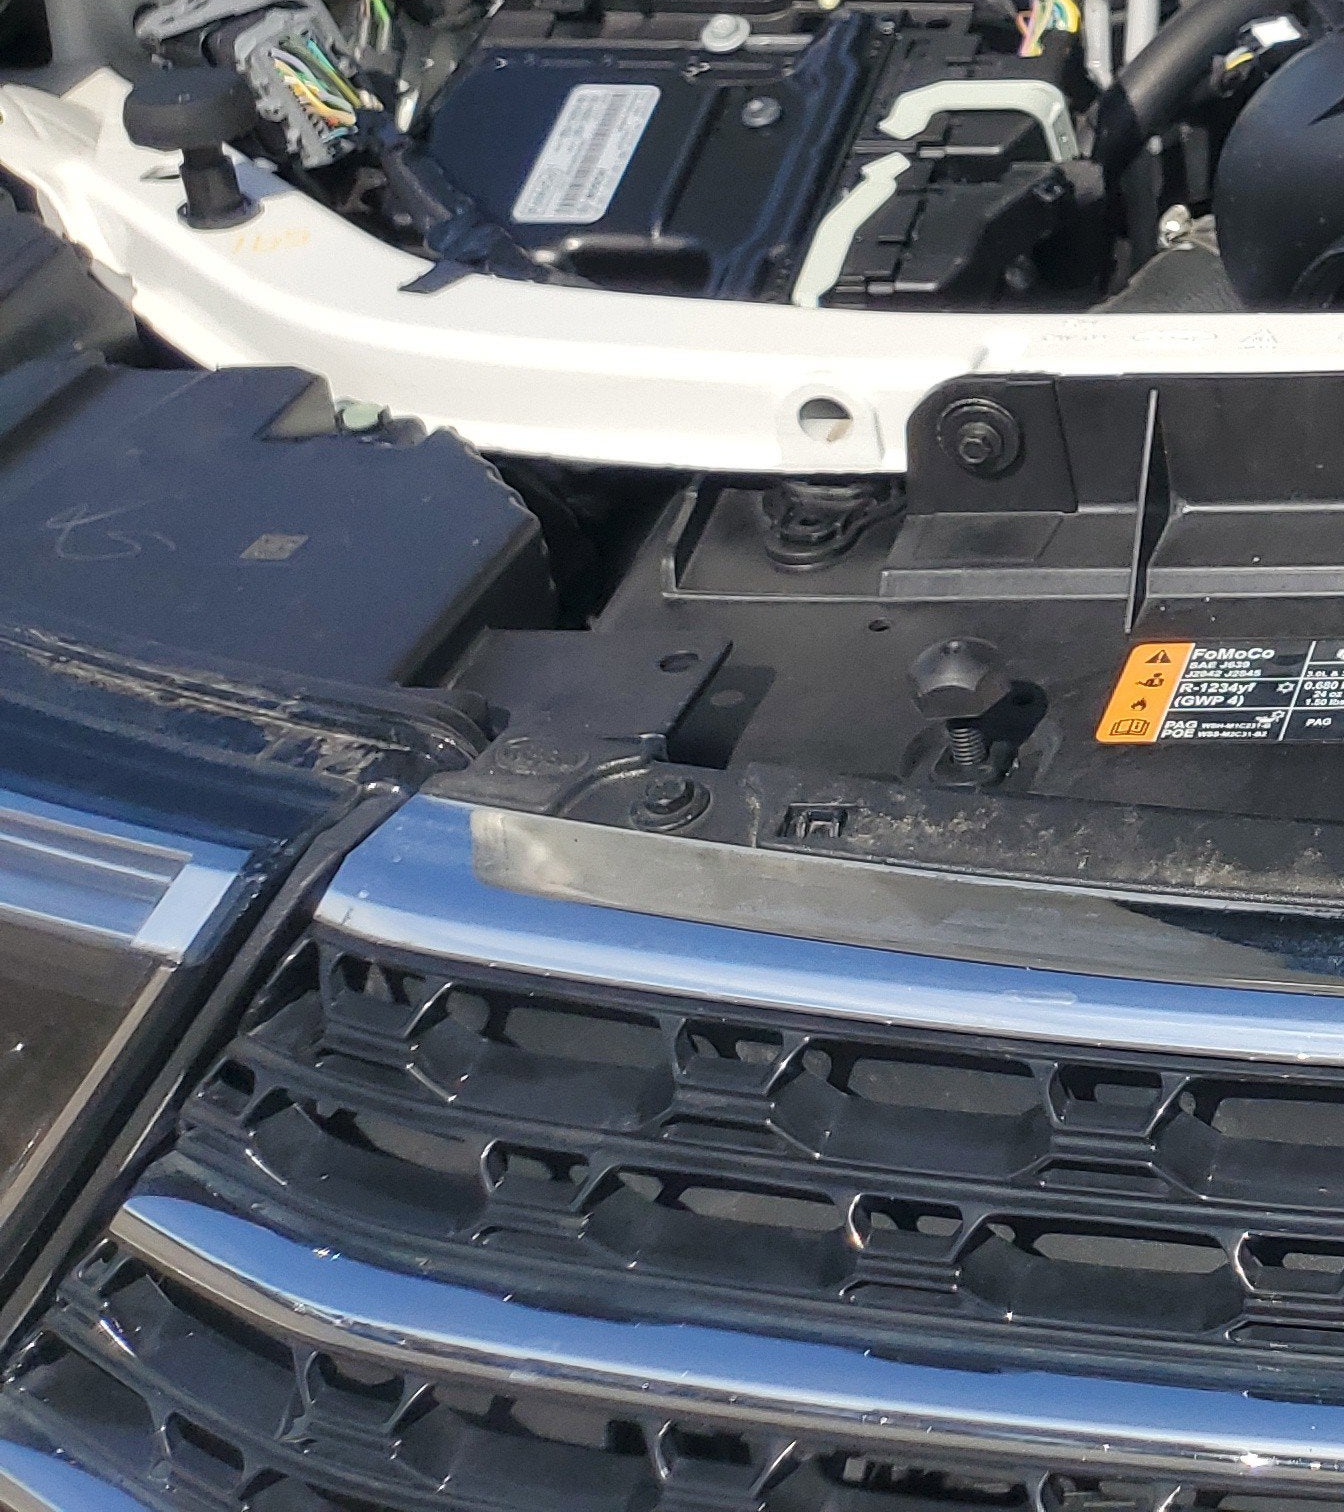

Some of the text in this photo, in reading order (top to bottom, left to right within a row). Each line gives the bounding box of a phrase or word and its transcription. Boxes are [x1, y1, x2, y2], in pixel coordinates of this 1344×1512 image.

[1191, 648, 1275, 660] FoMoCo
[1179, 682, 1258, 695] R-1234yf
[1173, 696, 1244, 707] (GWP 4)
[1164, 720, 1198, 729] PAG
[1305, 717, 1332, 727] PAG
[1160, 728, 1196, 739] POE
